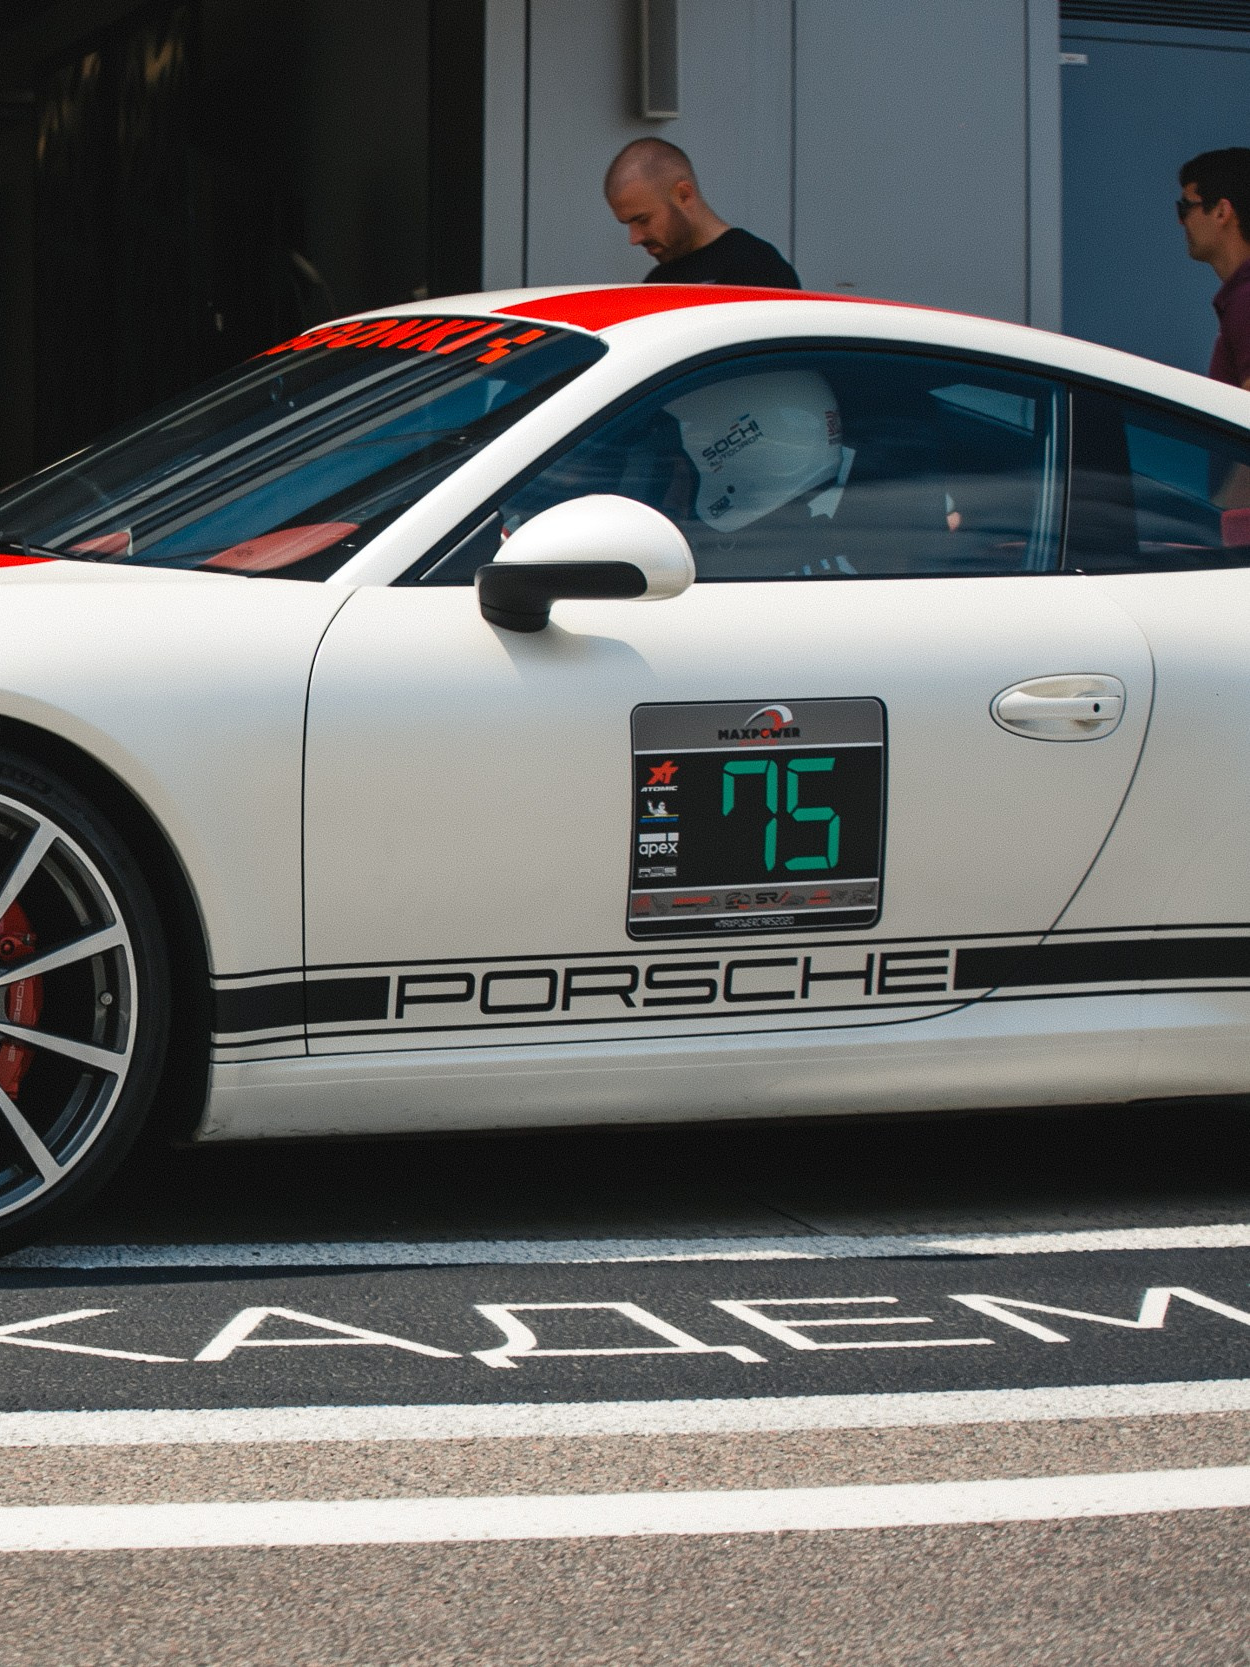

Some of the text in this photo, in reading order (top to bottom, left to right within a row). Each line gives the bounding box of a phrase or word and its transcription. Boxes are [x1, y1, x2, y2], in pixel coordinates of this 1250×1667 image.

[701, 419, 760, 461] SOCHI
[717, 727, 801, 741] MAXPOWER
[640, 785, 679, 793] ATOMIC
[721, 756, 841, 873] 75
[638, 842, 678, 858] apex
[394, 948, 950, 1020] PORSCHE
